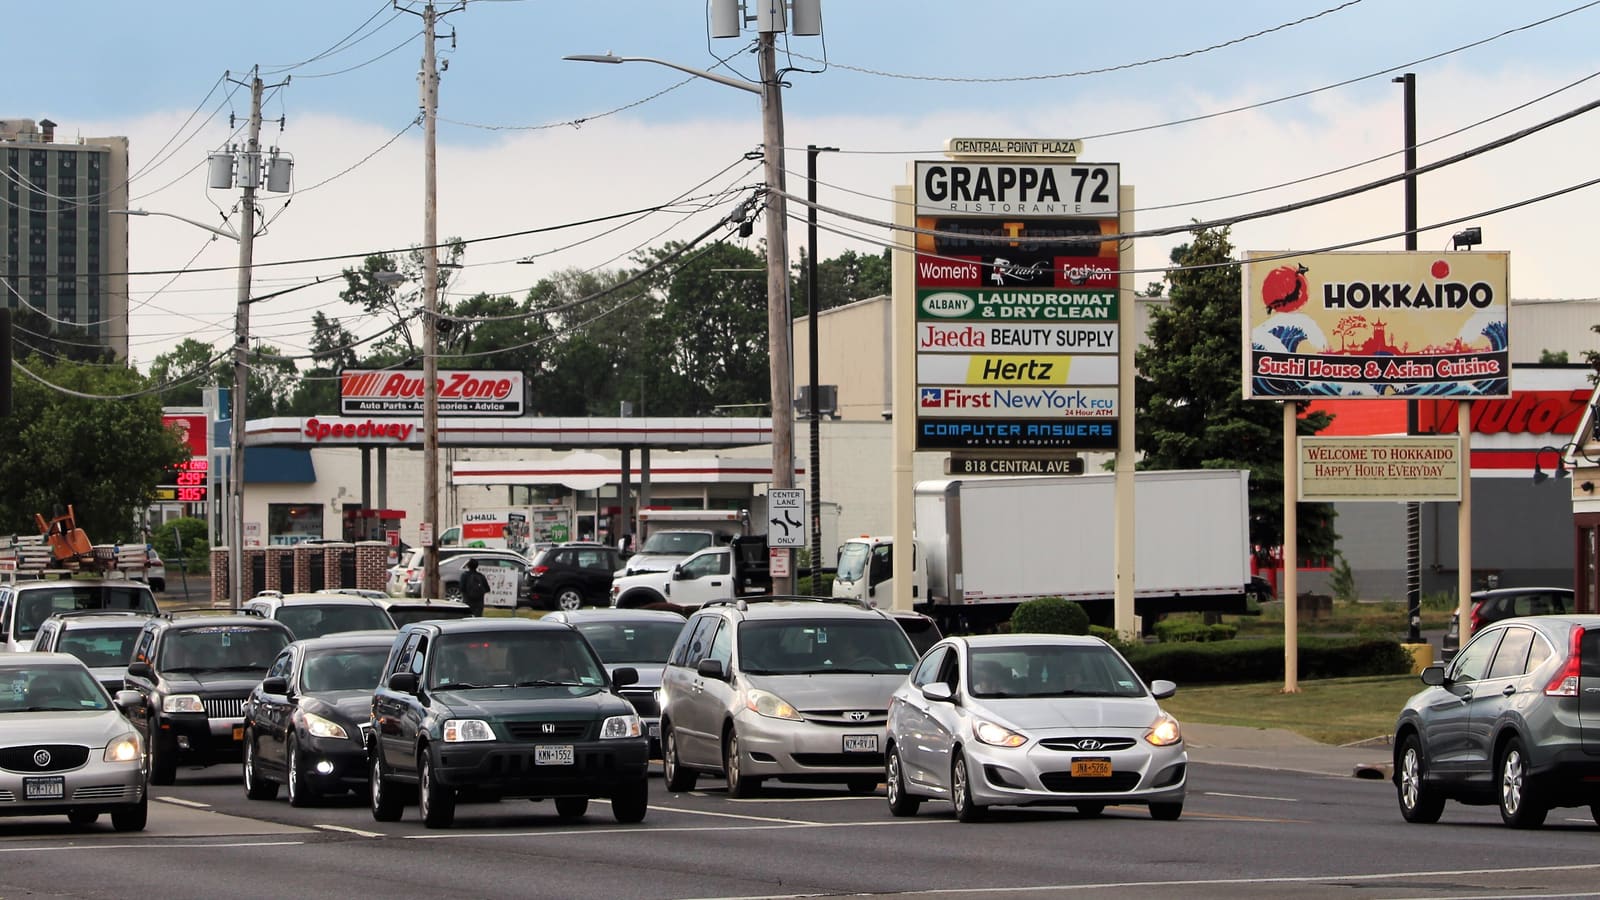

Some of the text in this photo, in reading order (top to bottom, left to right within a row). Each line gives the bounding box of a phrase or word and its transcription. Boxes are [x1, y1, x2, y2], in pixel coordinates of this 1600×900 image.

[955, 141, 1077, 153] CENTRAL POINT PLAZA
[925, 166, 1109, 203] GRAPPA 72
[950, 203, 1082, 213] RISTORANTE
[920, 263, 978, 280] Women's
[978, 293, 1115, 305] LAUNDROMAT
[1324, 282, 1493, 309] HOKKAIDO
[928, 300, 969, 310] ALBANY
[981, 307, 1108, 318] & DRY CLEAN
[921, 326, 1114, 348] Jaeda BEAUTY SUPPLY
[982, 359, 1053, 380] Hertz
[1259, 357, 1499, 378] Sushi House & Asian Cuisine
[944, 389, 991, 408] First
[1091, 400, 1113, 409] FCU
[360, 402, 381, 410] Auto
[383, 402, 406, 410] Parts
[475, 402, 505, 410] Advice
[304, 418, 414, 441] Speedway
[924, 424, 1113, 436] COMPUTER ANSWERS
[965, 460, 1070, 472] 818 CENTRAL AVE
[466, 513, 497, 521] U-HAUL
